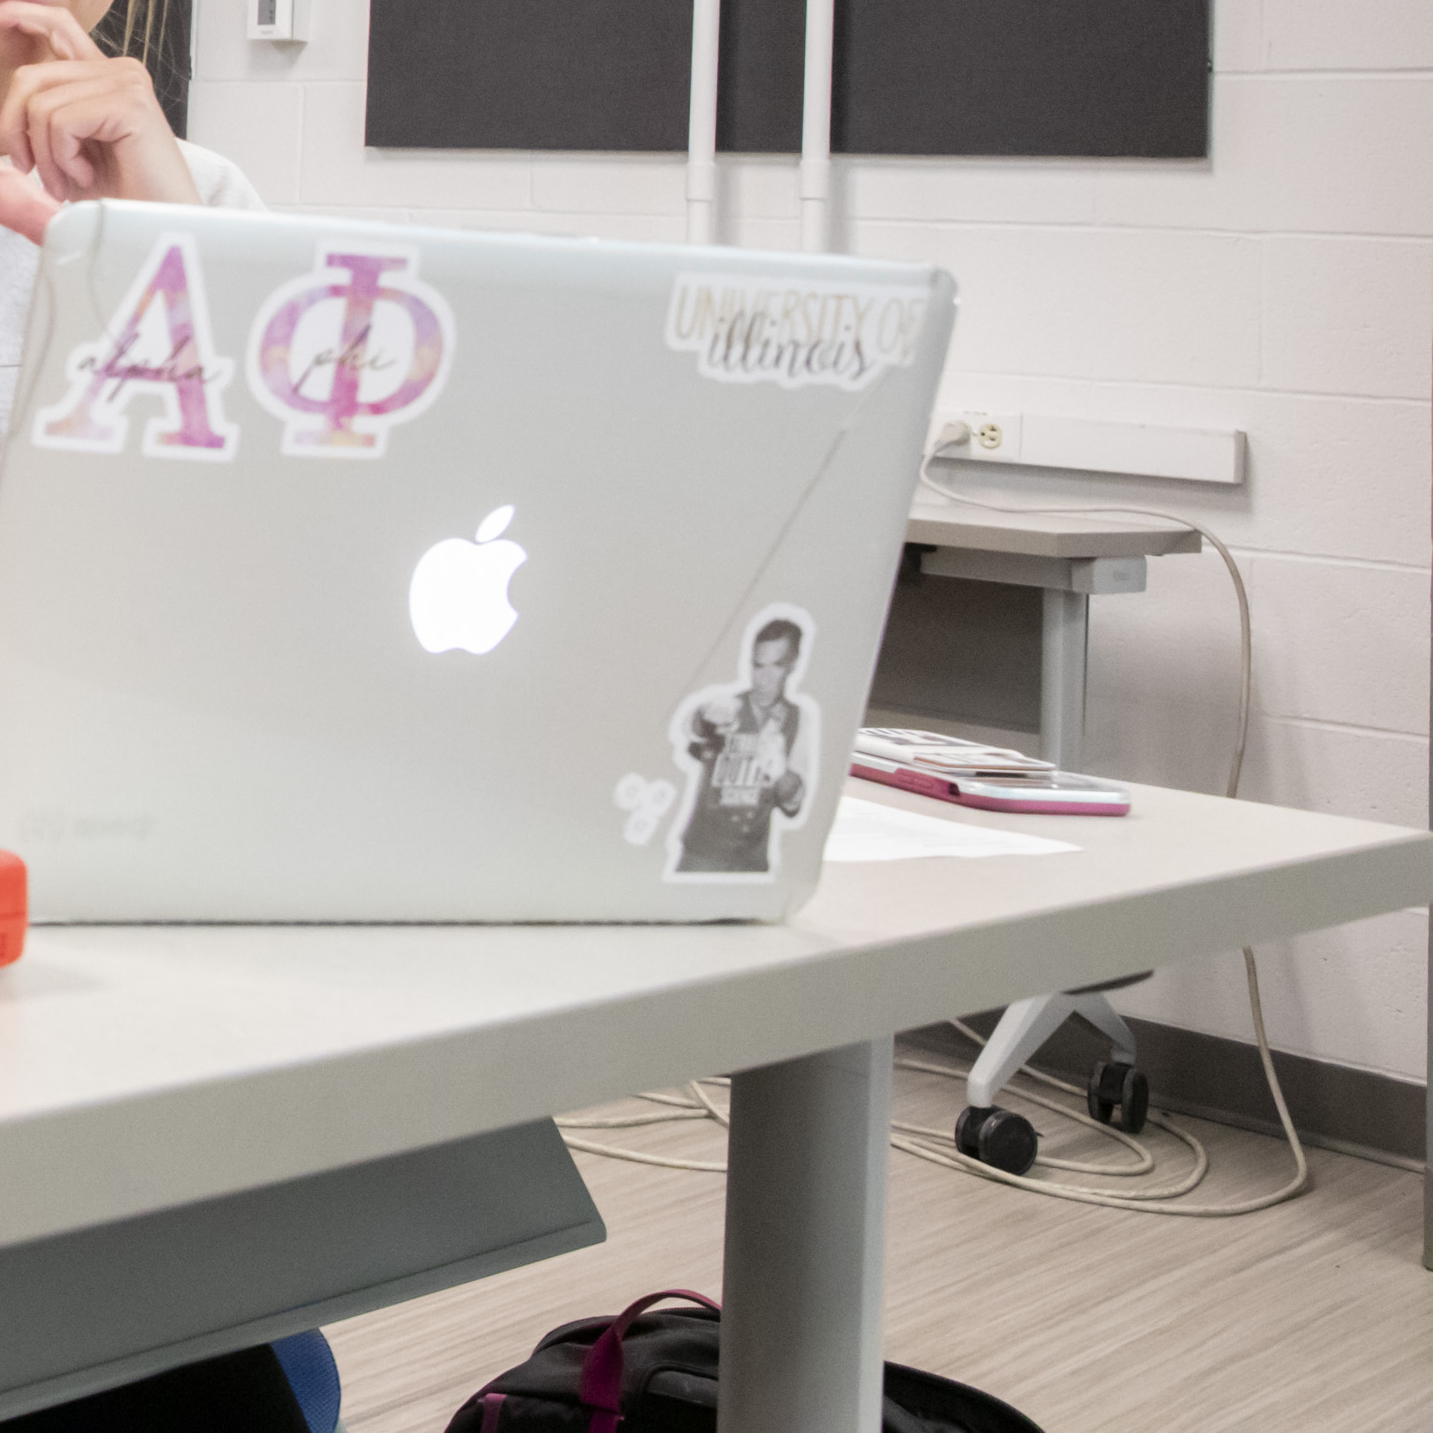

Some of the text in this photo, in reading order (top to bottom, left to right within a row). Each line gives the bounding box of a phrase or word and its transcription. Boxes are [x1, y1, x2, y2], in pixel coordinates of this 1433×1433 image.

[76, 330, 221, 403] alpha
[291, 323, 401, 395] phi
[709, 310, 875, 381] illinois
